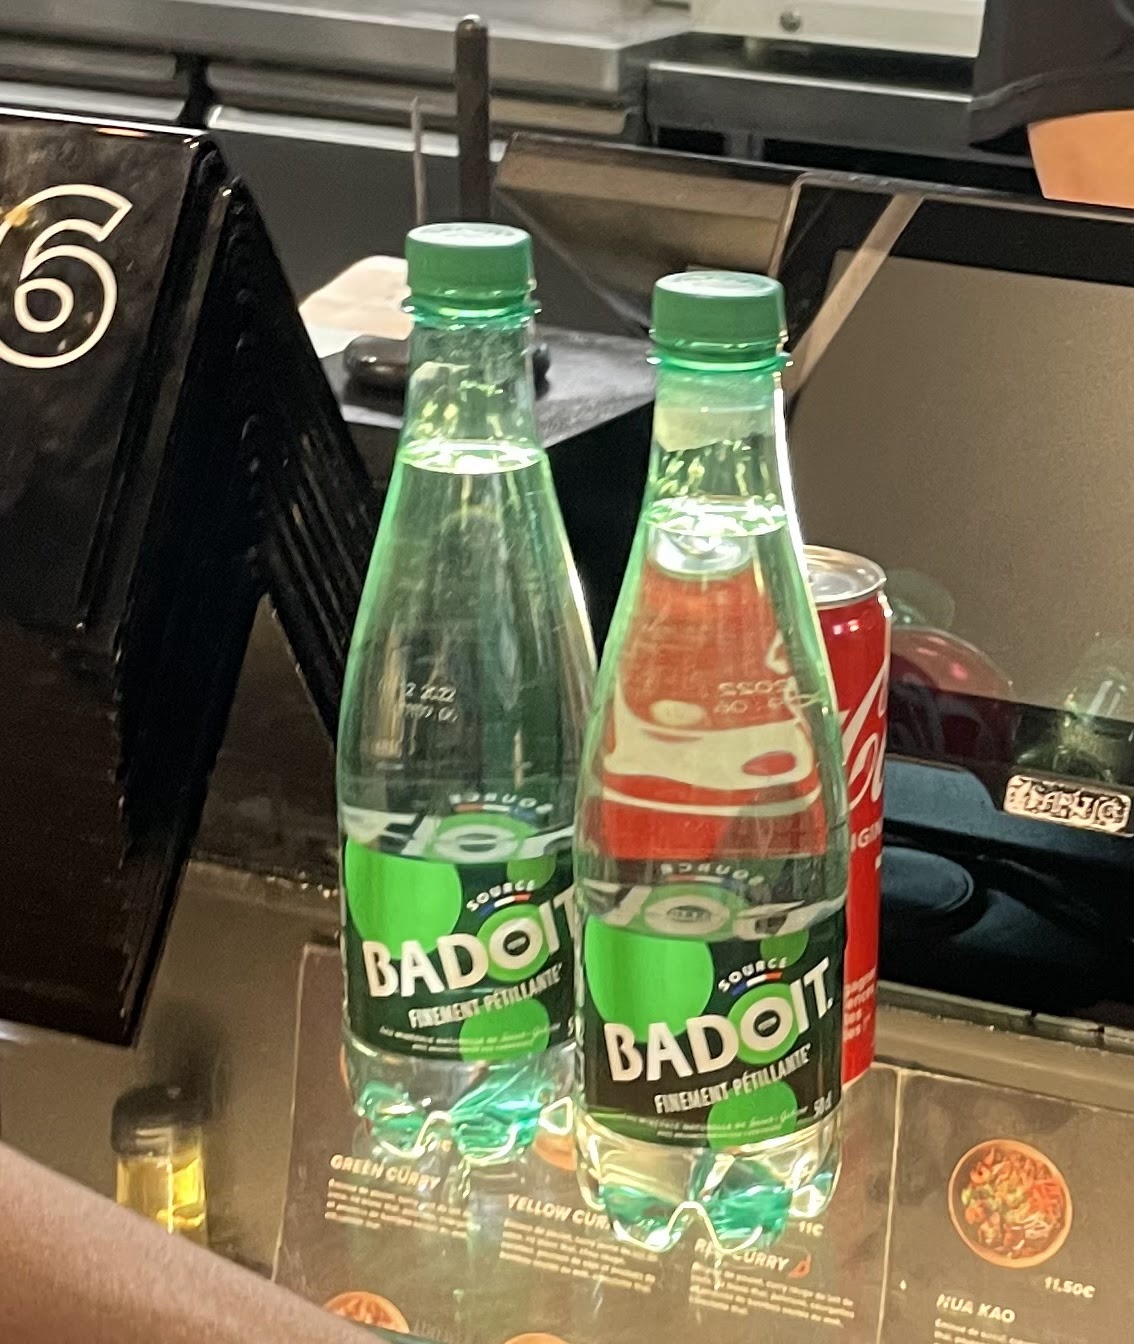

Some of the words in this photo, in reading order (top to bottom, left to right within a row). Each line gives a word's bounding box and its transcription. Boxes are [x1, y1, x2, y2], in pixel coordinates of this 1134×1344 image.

[0, 183, 133, 369] 6
[466, 879, 535, 912] SOURCE
[362, 883, 576, 997] BADOIT
[718, 956, 788, 992] SOURCE
[408, 999, 480, 1028] FINEMENT
[604, 957, 833, 1081] BADOIT
[654, 1082, 729, 1113] FINEMENT
[330, 1154, 384, 1179] GREEN
[385, 1165, 441, 1191] CURRY
[508, 1193, 572, 1221] YELLOW
[572, 1209, 611, 1230] CUR
[977, 1303, 1016, 1323] KAO
